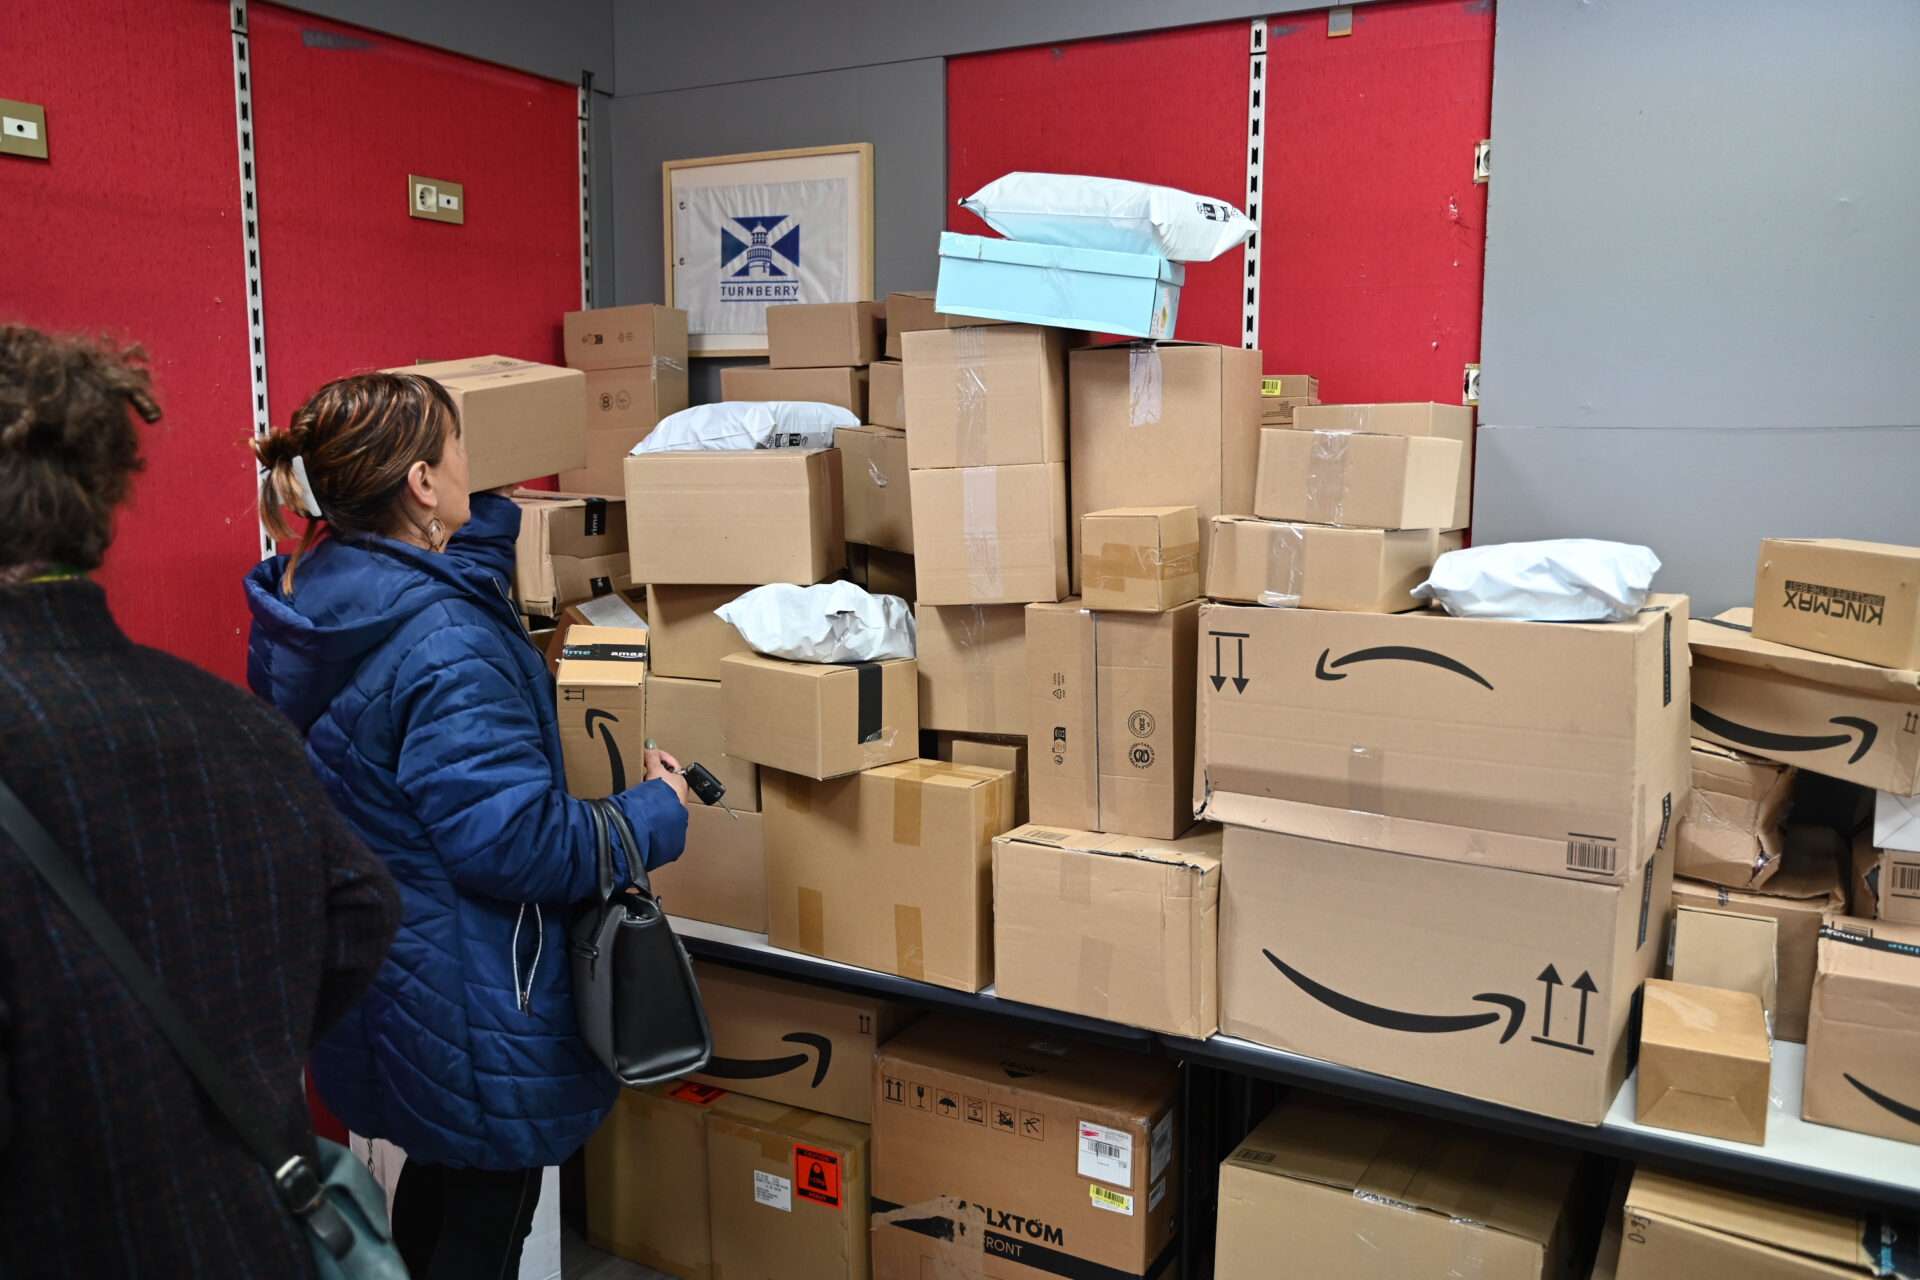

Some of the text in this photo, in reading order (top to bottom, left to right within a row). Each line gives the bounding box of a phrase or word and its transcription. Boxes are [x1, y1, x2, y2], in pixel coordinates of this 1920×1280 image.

[720, 286, 799, 297] TURNBERRY
[1782, 590, 1884, 626] KINCMAX
[984, 1236, 1024, 1257] RONT
